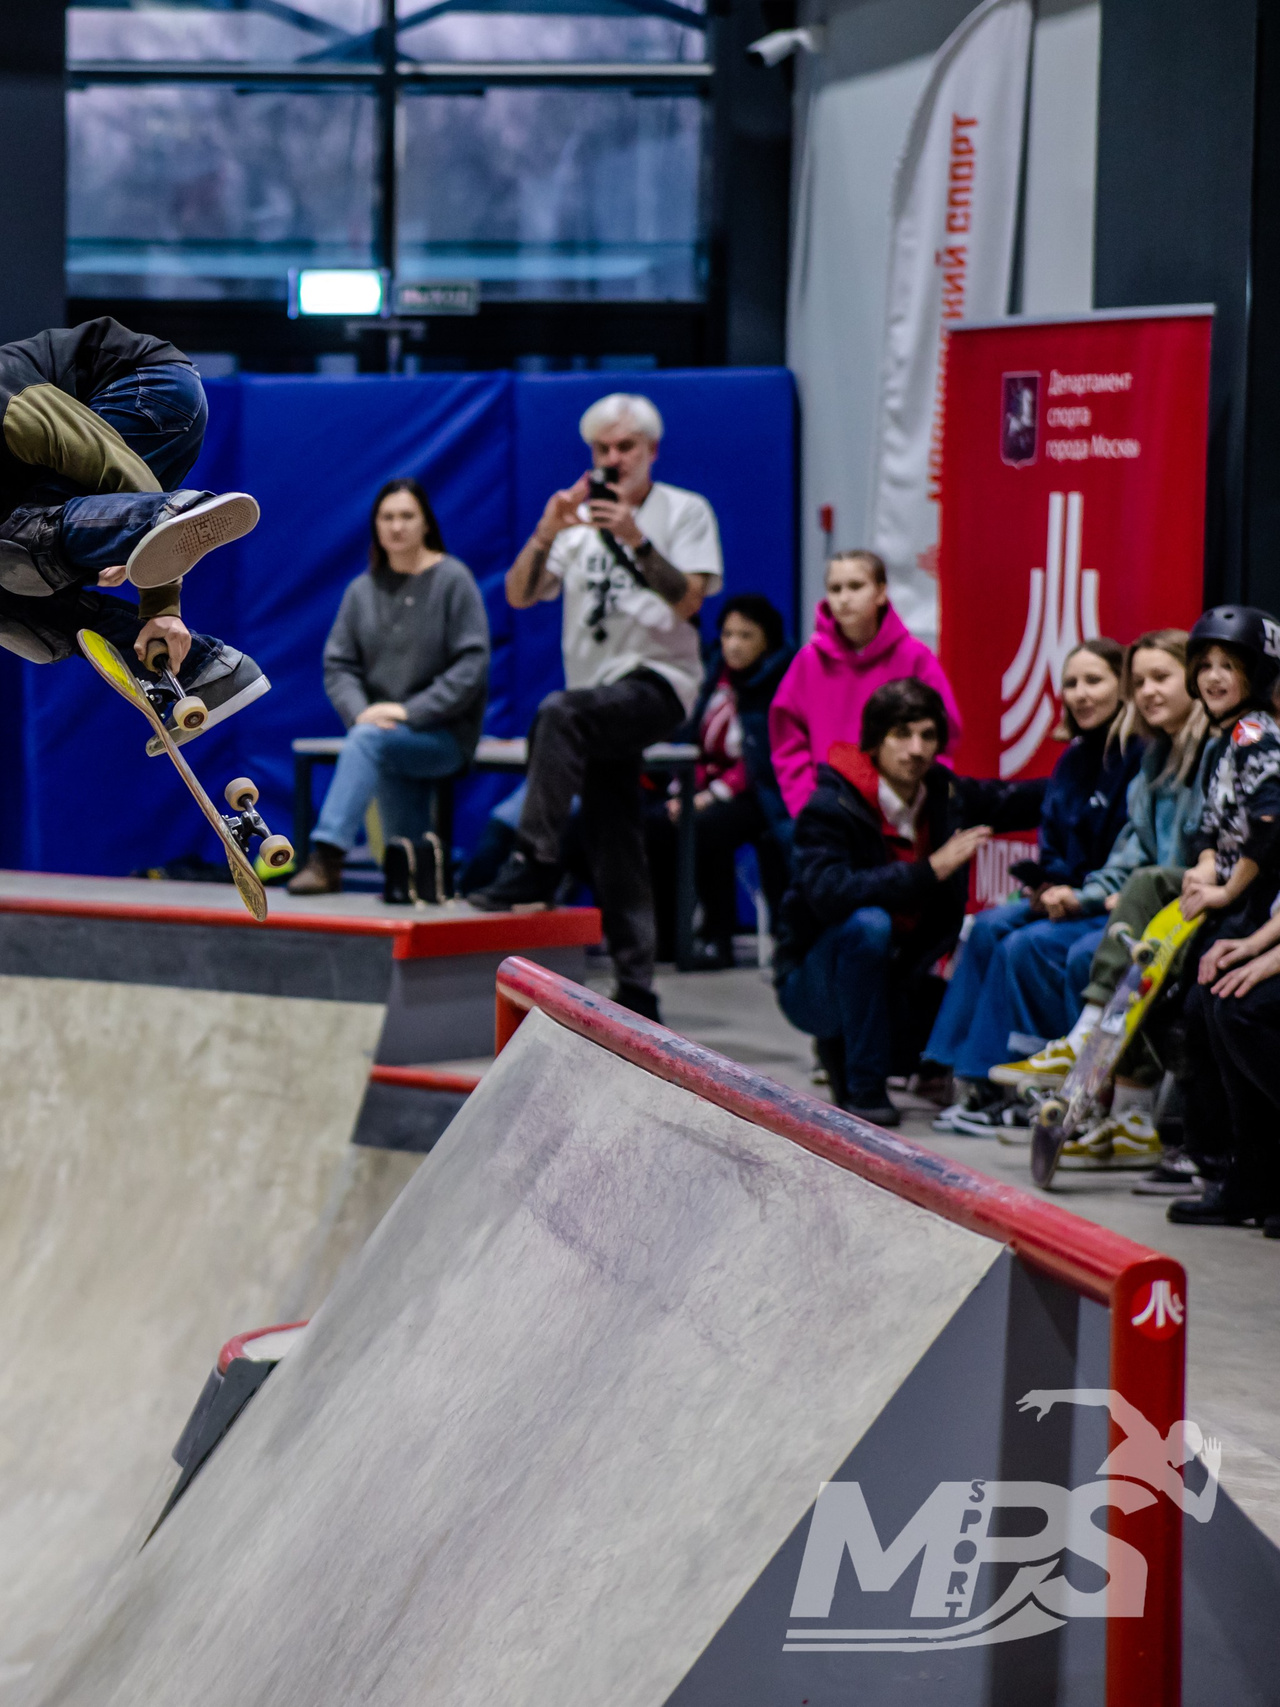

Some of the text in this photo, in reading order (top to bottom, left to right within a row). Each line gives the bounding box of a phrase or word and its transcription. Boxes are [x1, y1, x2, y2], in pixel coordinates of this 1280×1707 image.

[946, 112, 978, 234] СПОРТ
[1048, 369, 1132, 396] Департамент
[1047, 406, 1092, 431] спорта
[1046, 439, 1089, 462] города
